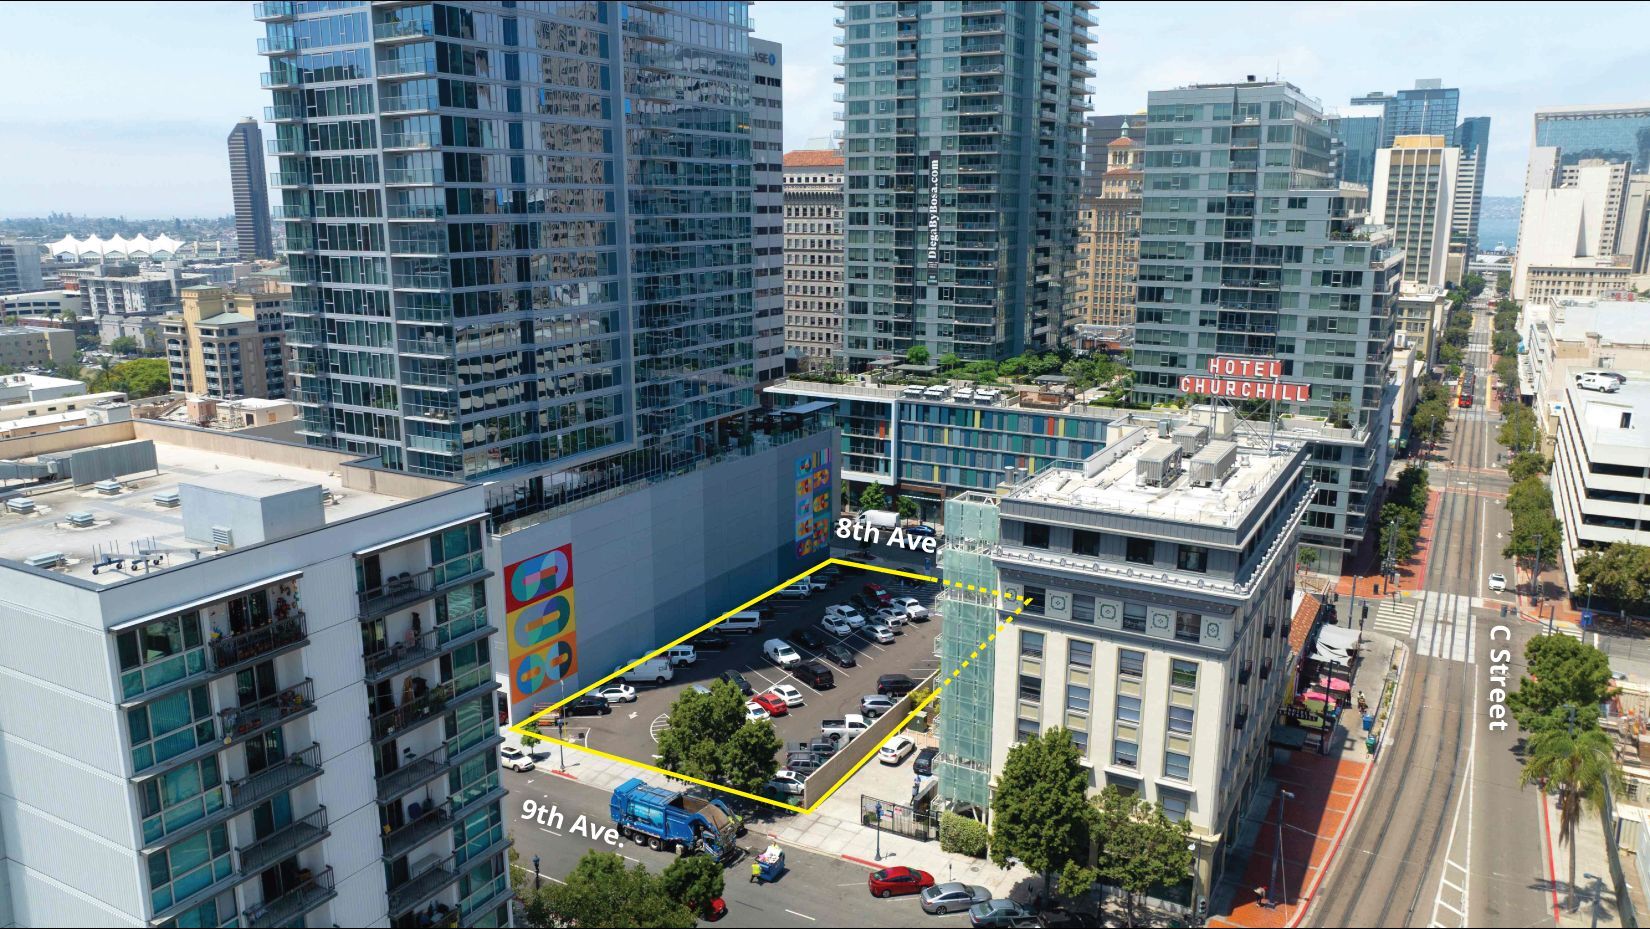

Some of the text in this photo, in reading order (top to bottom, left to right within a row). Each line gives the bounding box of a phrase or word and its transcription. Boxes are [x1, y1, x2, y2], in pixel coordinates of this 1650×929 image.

[928, 159, 940, 259] DiegaByBosa.com
[1209, 358, 1279, 378] HOTEL
[1181, 377, 1308, 401] CHURCHILL
